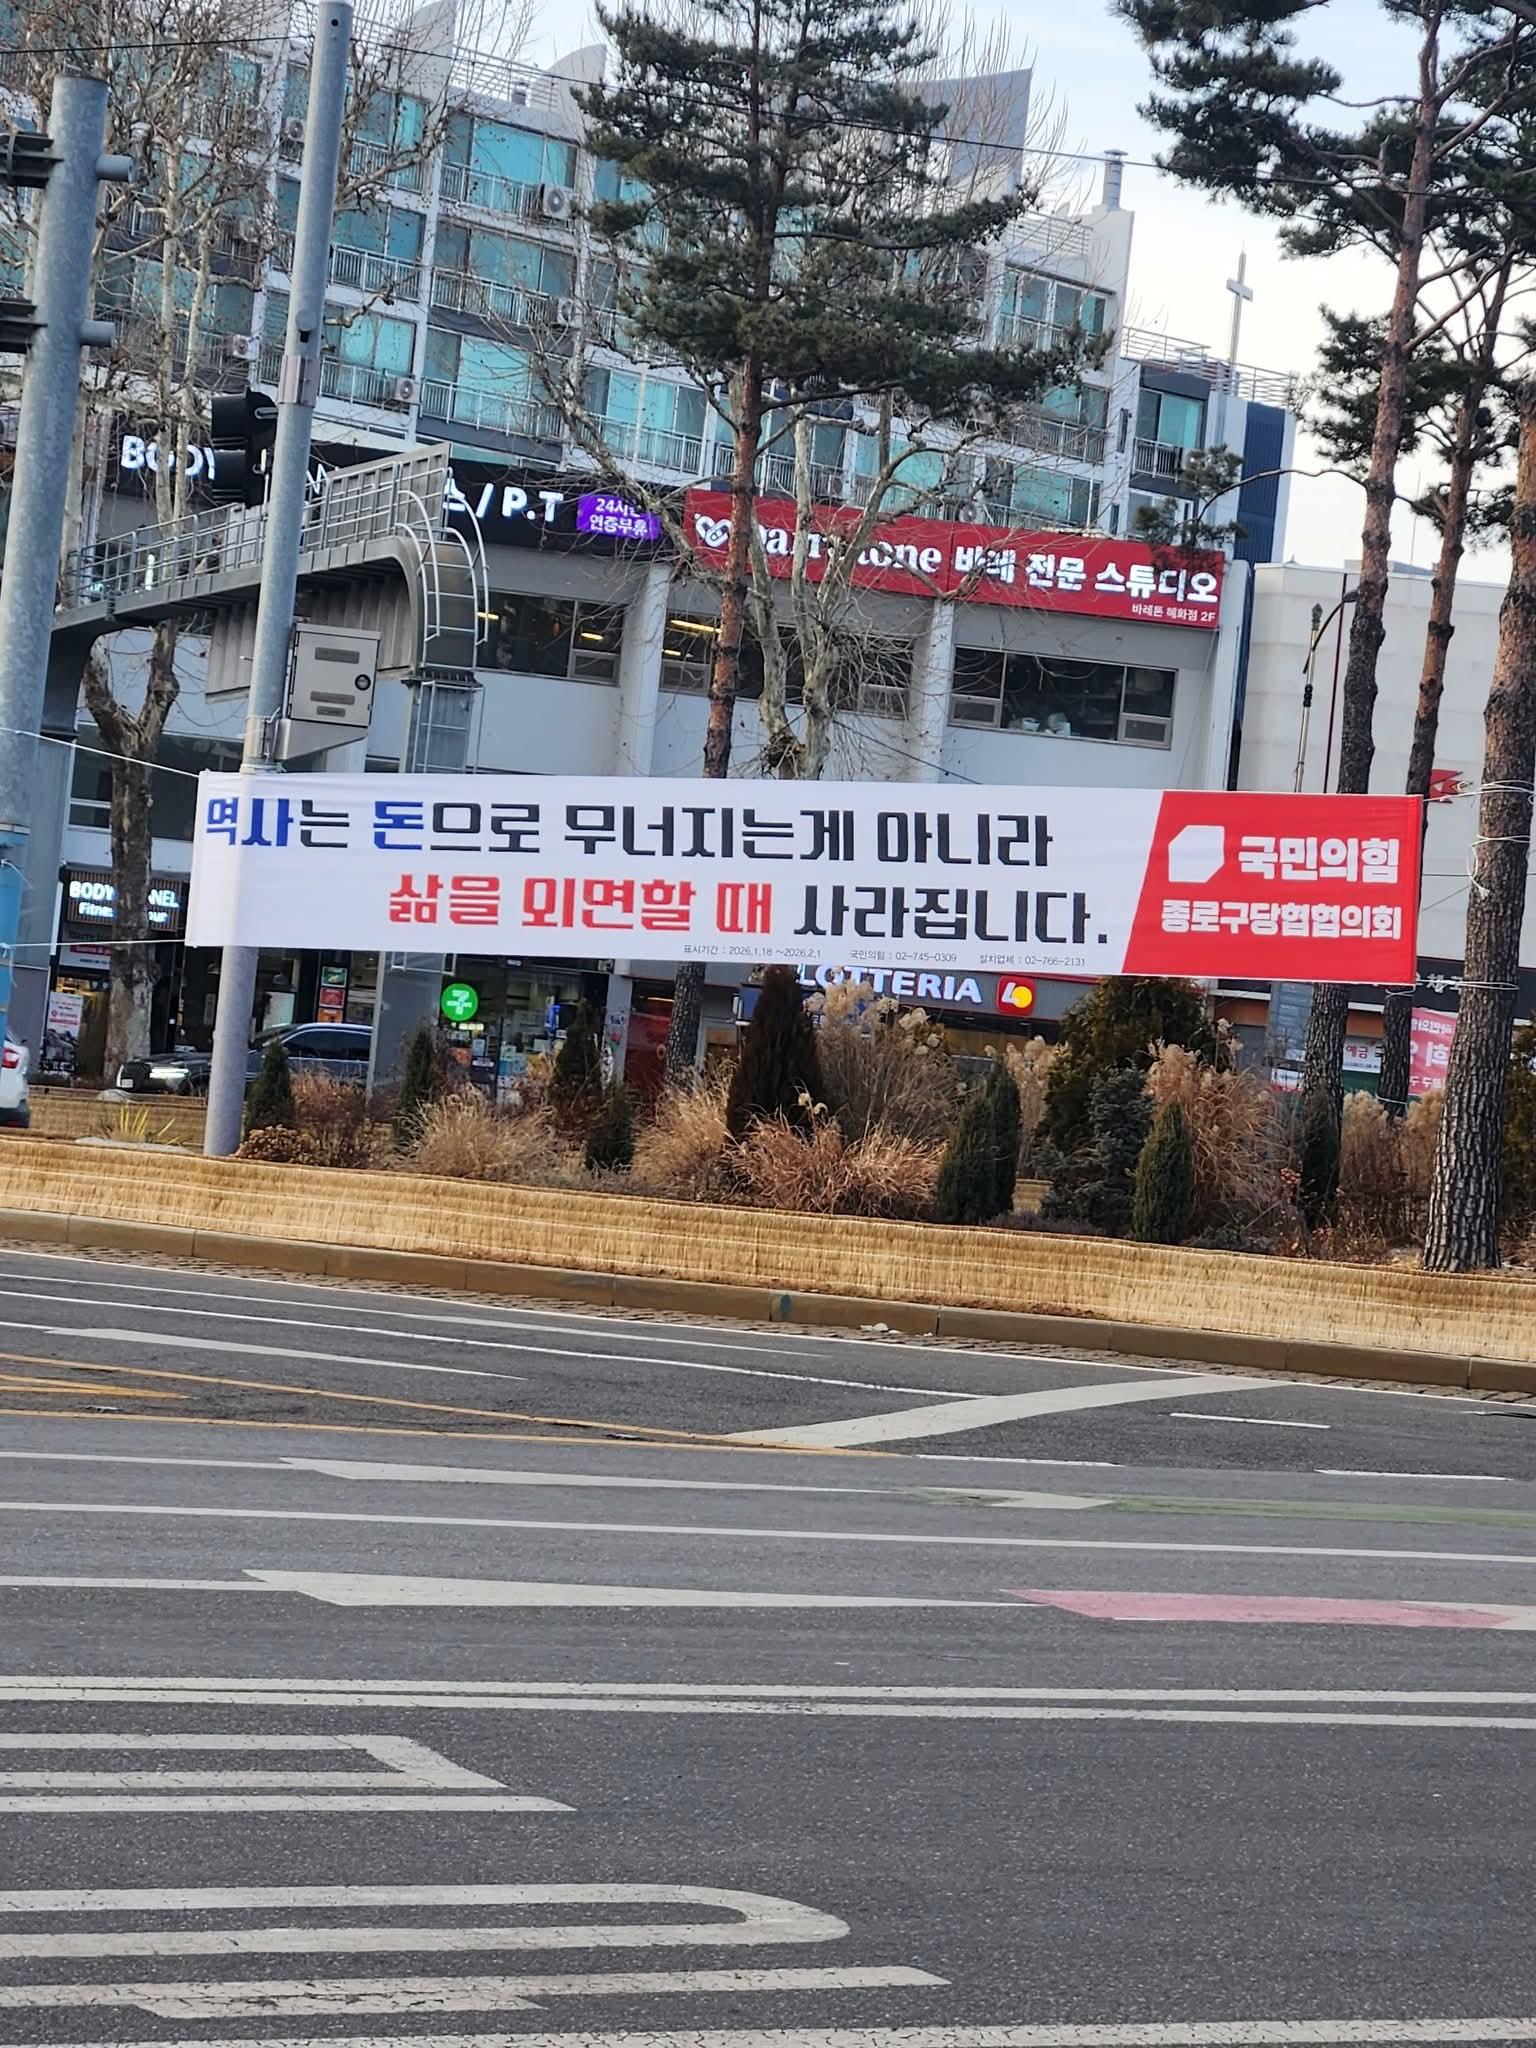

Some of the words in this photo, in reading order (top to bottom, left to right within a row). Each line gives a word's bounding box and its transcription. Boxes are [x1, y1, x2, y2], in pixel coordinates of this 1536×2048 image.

[1025, 553, 1087, 591] 전문
[1094, 562, 1218, 603] 스튜디오
[1132, 603, 1164, 618] 바레톤
[1200, 611, 1216, 622] 2F
[206, 797, 350, 848] 역사는
[373, 801, 540, 853] 돈으로
[565, 805, 855, 861] 무너지는게
[877, 811, 1053, 867] 아니라
[1238, 836, 1399, 884] 국민의힘
[69, 881, 114, 900] BODY
[389, 874, 500, 926] 삶을
[522, 878, 696, 932] 외면할
[717, 882, 772, 934] 때
[794, 885, 1107, 944] 사라집니다.
[1161, 899, 1402, 940] 종로구당협협의회
[684, 944, 719, 955] 표시기간
[850, 950, 885, 961] 국민의힘
[896, 951, 957, 962] 02-745-0309
[796, 963, 982, 1003] LOTTERIA
